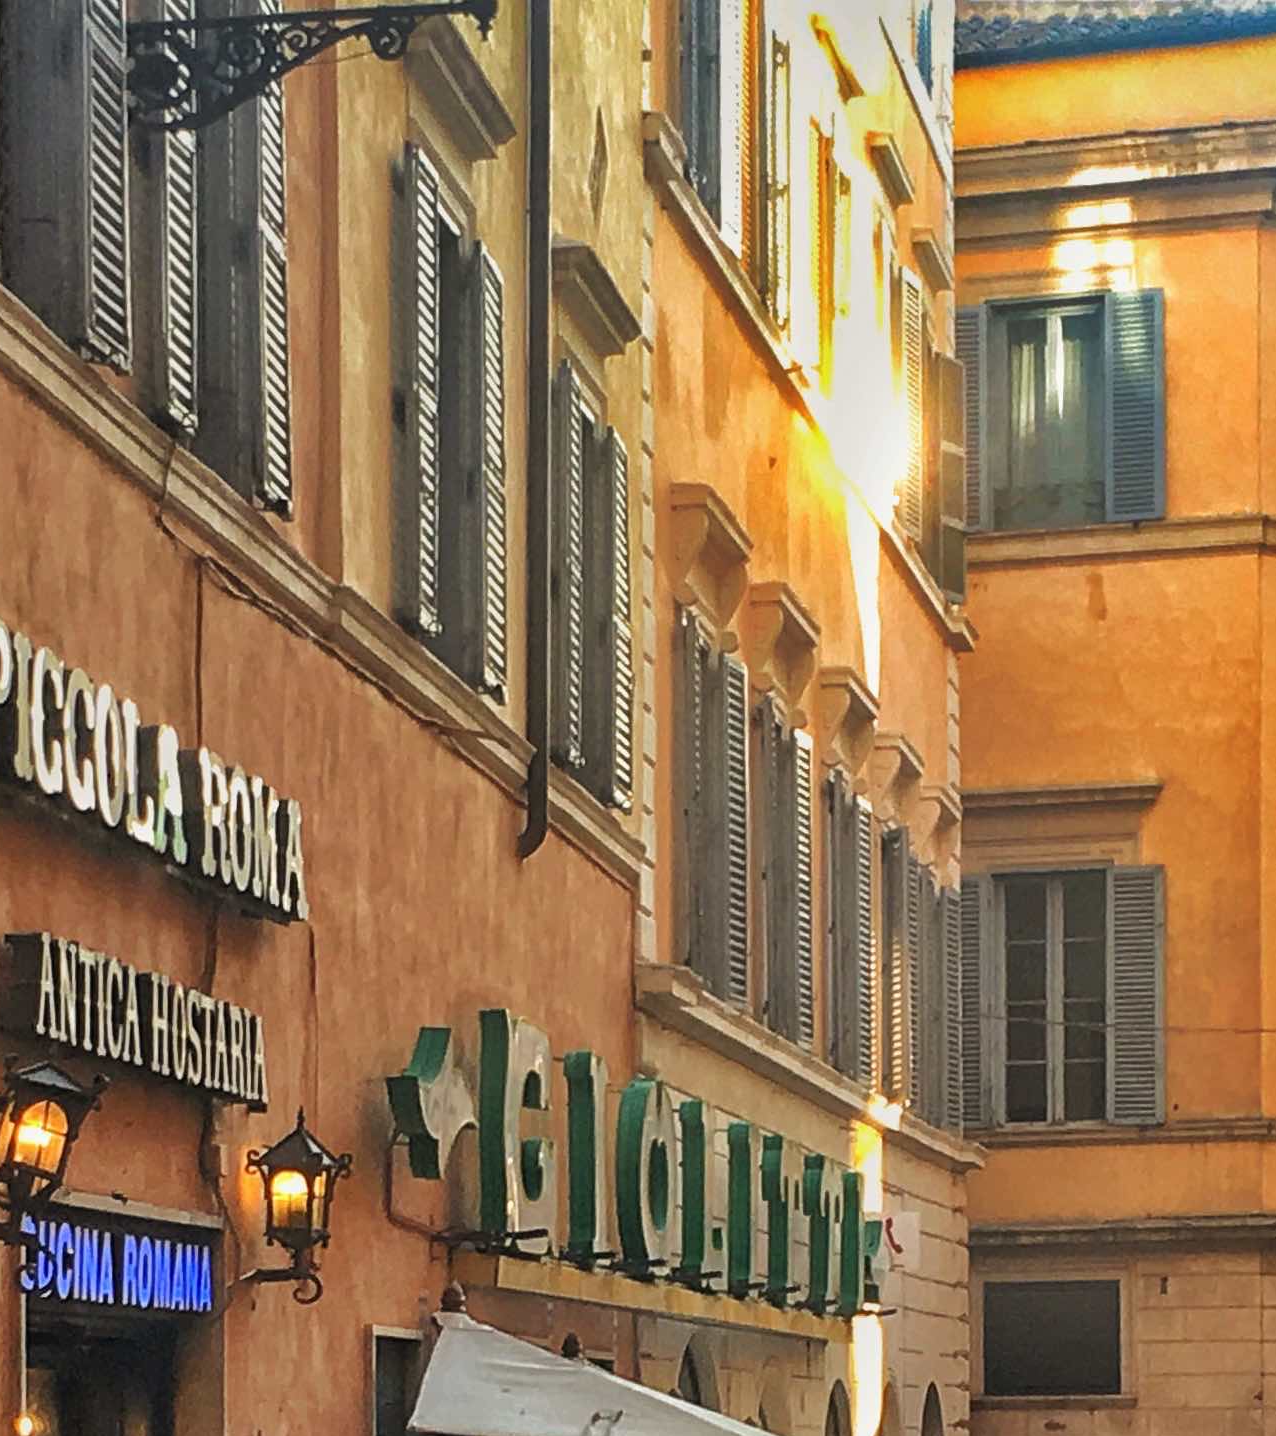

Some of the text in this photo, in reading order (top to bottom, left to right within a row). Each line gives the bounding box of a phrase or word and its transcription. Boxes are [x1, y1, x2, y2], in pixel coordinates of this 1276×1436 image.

[198, 746, 309, 920] ROMA
[36, 933, 269, 1104] ANTICA HOSTARIA
[122, 1233, 212, 1312] ROMANA
